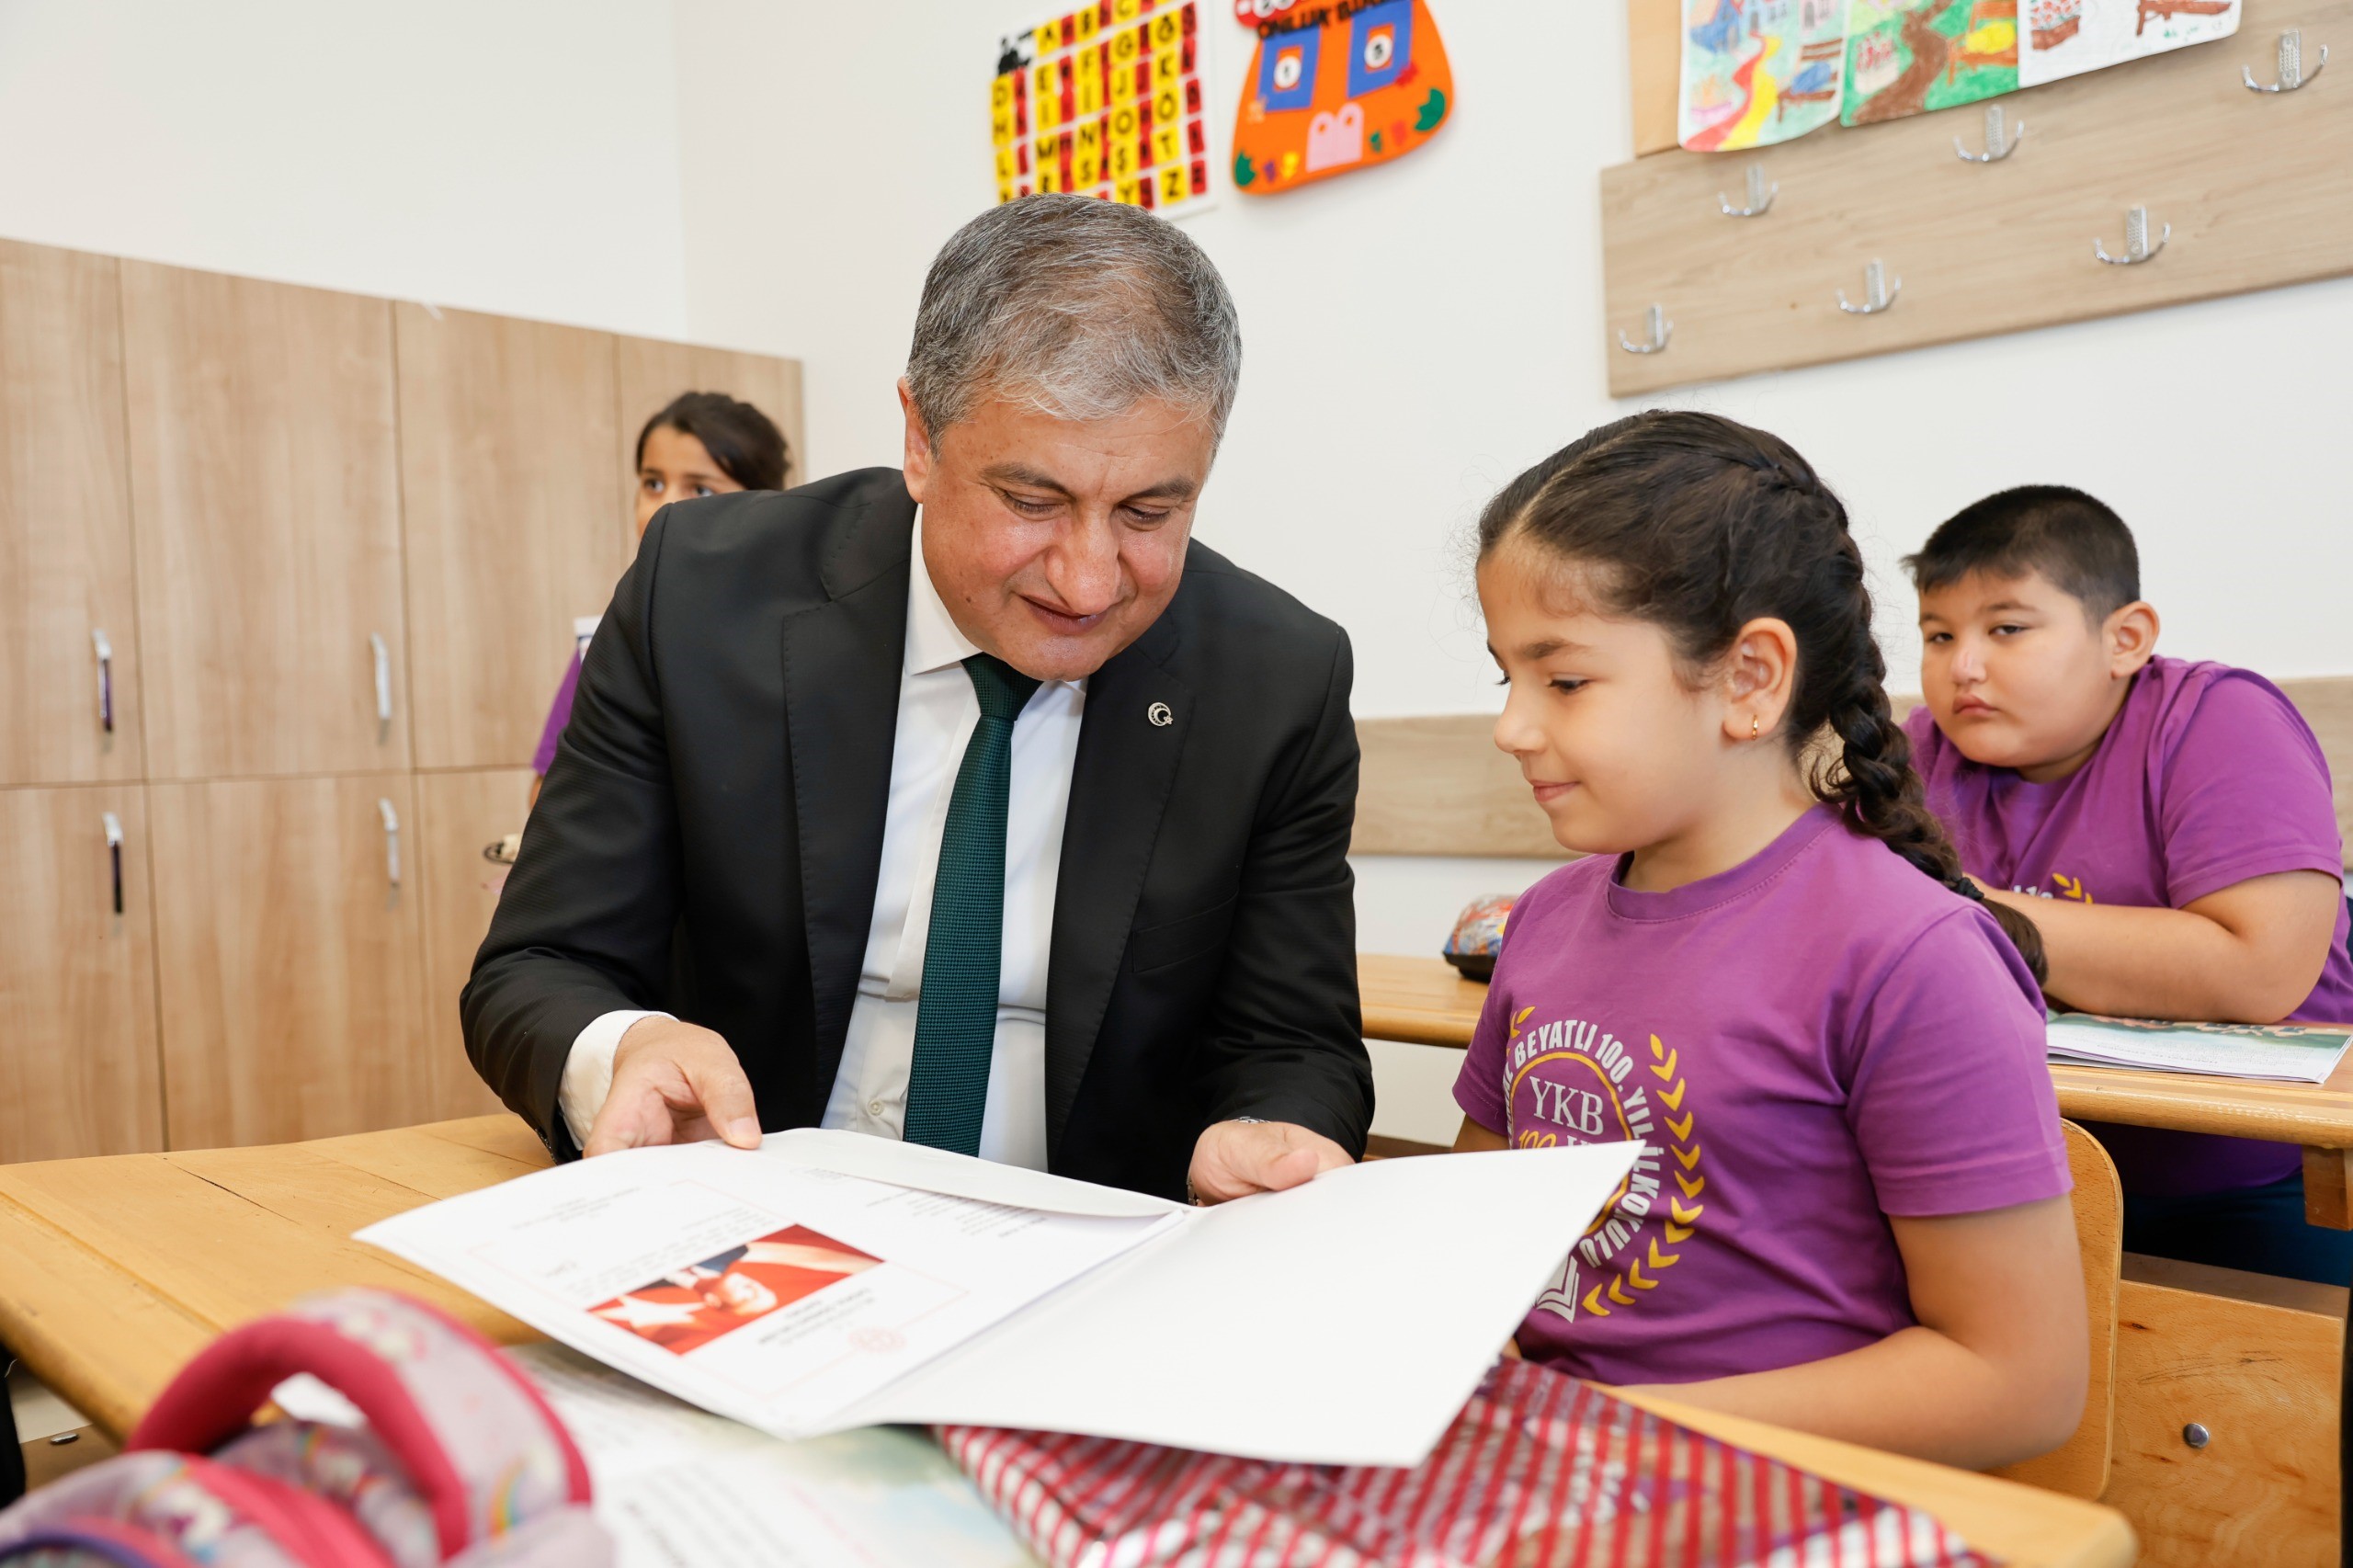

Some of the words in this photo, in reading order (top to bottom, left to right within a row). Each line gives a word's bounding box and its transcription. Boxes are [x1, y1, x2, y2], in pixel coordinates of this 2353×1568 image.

[1515, 1019, 1598, 1070] BEYATLI
[1623, 1085, 1655, 1140] YIL
[1529, 1075, 1605, 1136] YKB
